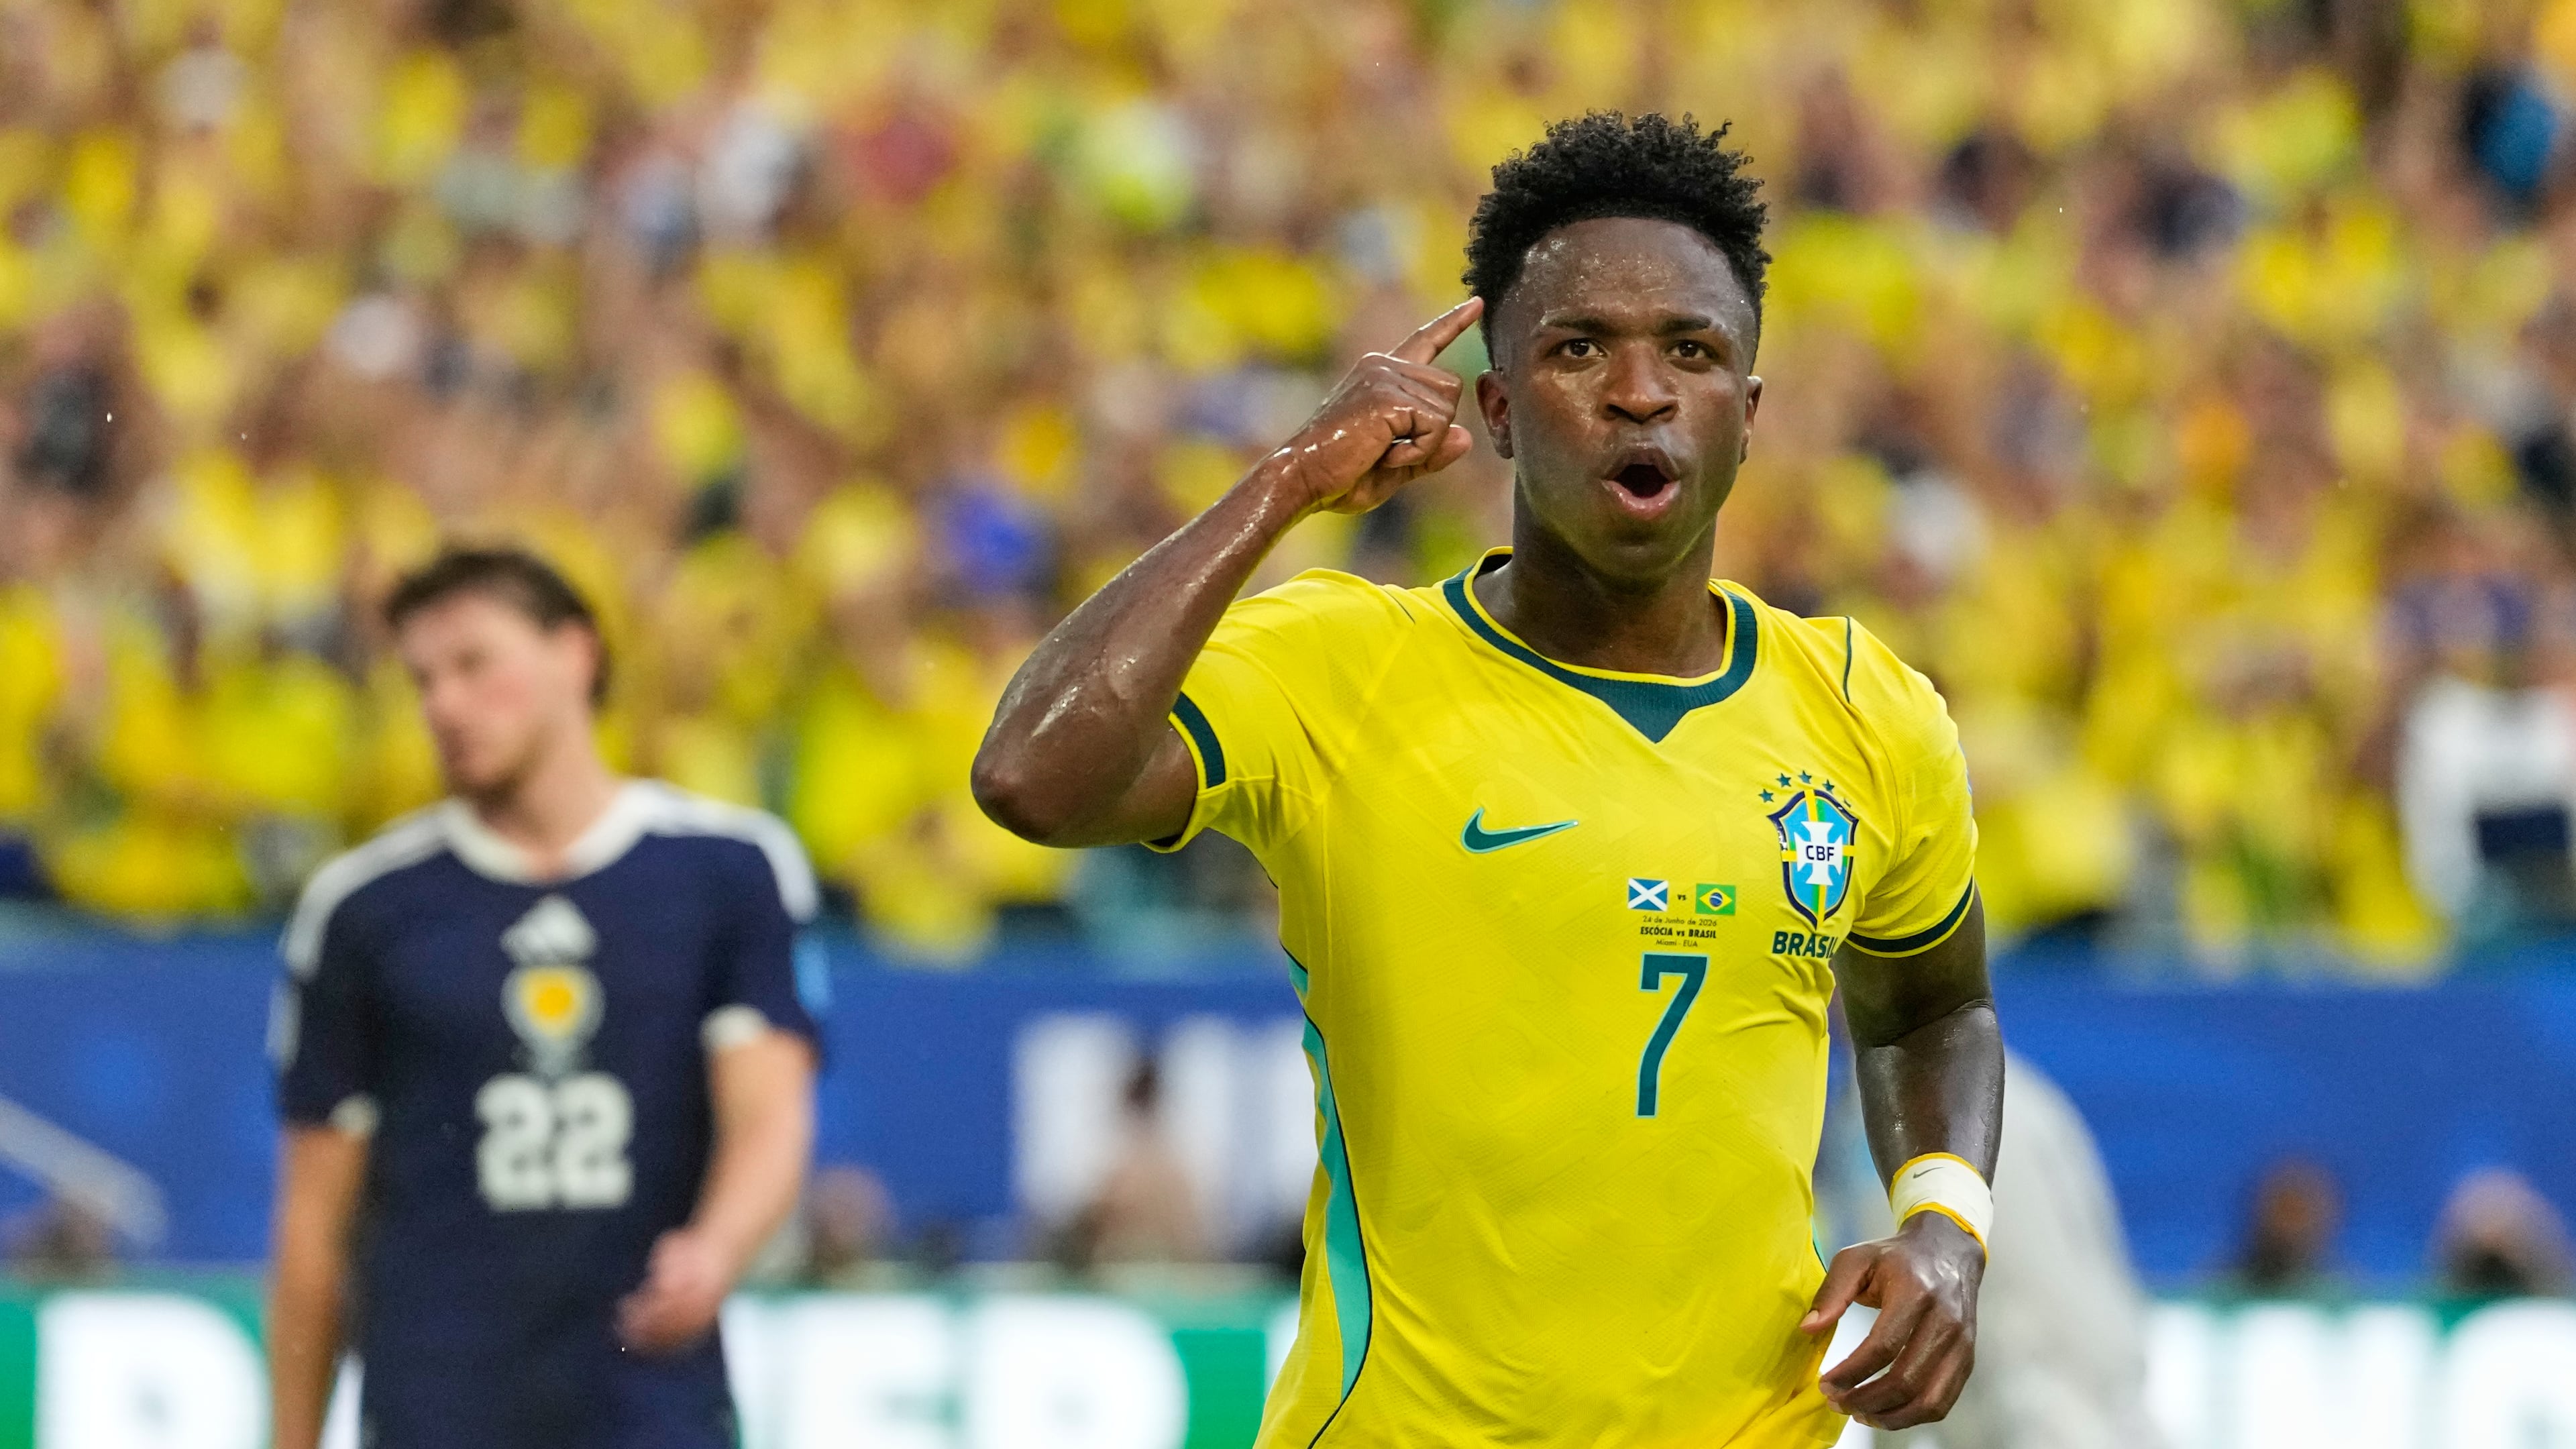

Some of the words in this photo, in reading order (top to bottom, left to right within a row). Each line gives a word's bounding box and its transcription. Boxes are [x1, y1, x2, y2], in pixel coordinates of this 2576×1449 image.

[1805, 845, 1835, 862] CBF
[1688, 929, 1717, 938] BRASIL
[1772, 931, 1838, 959] BRASIL
[1636, 953, 1709, 1119] 7
[474, 1071, 635, 1210] 22
